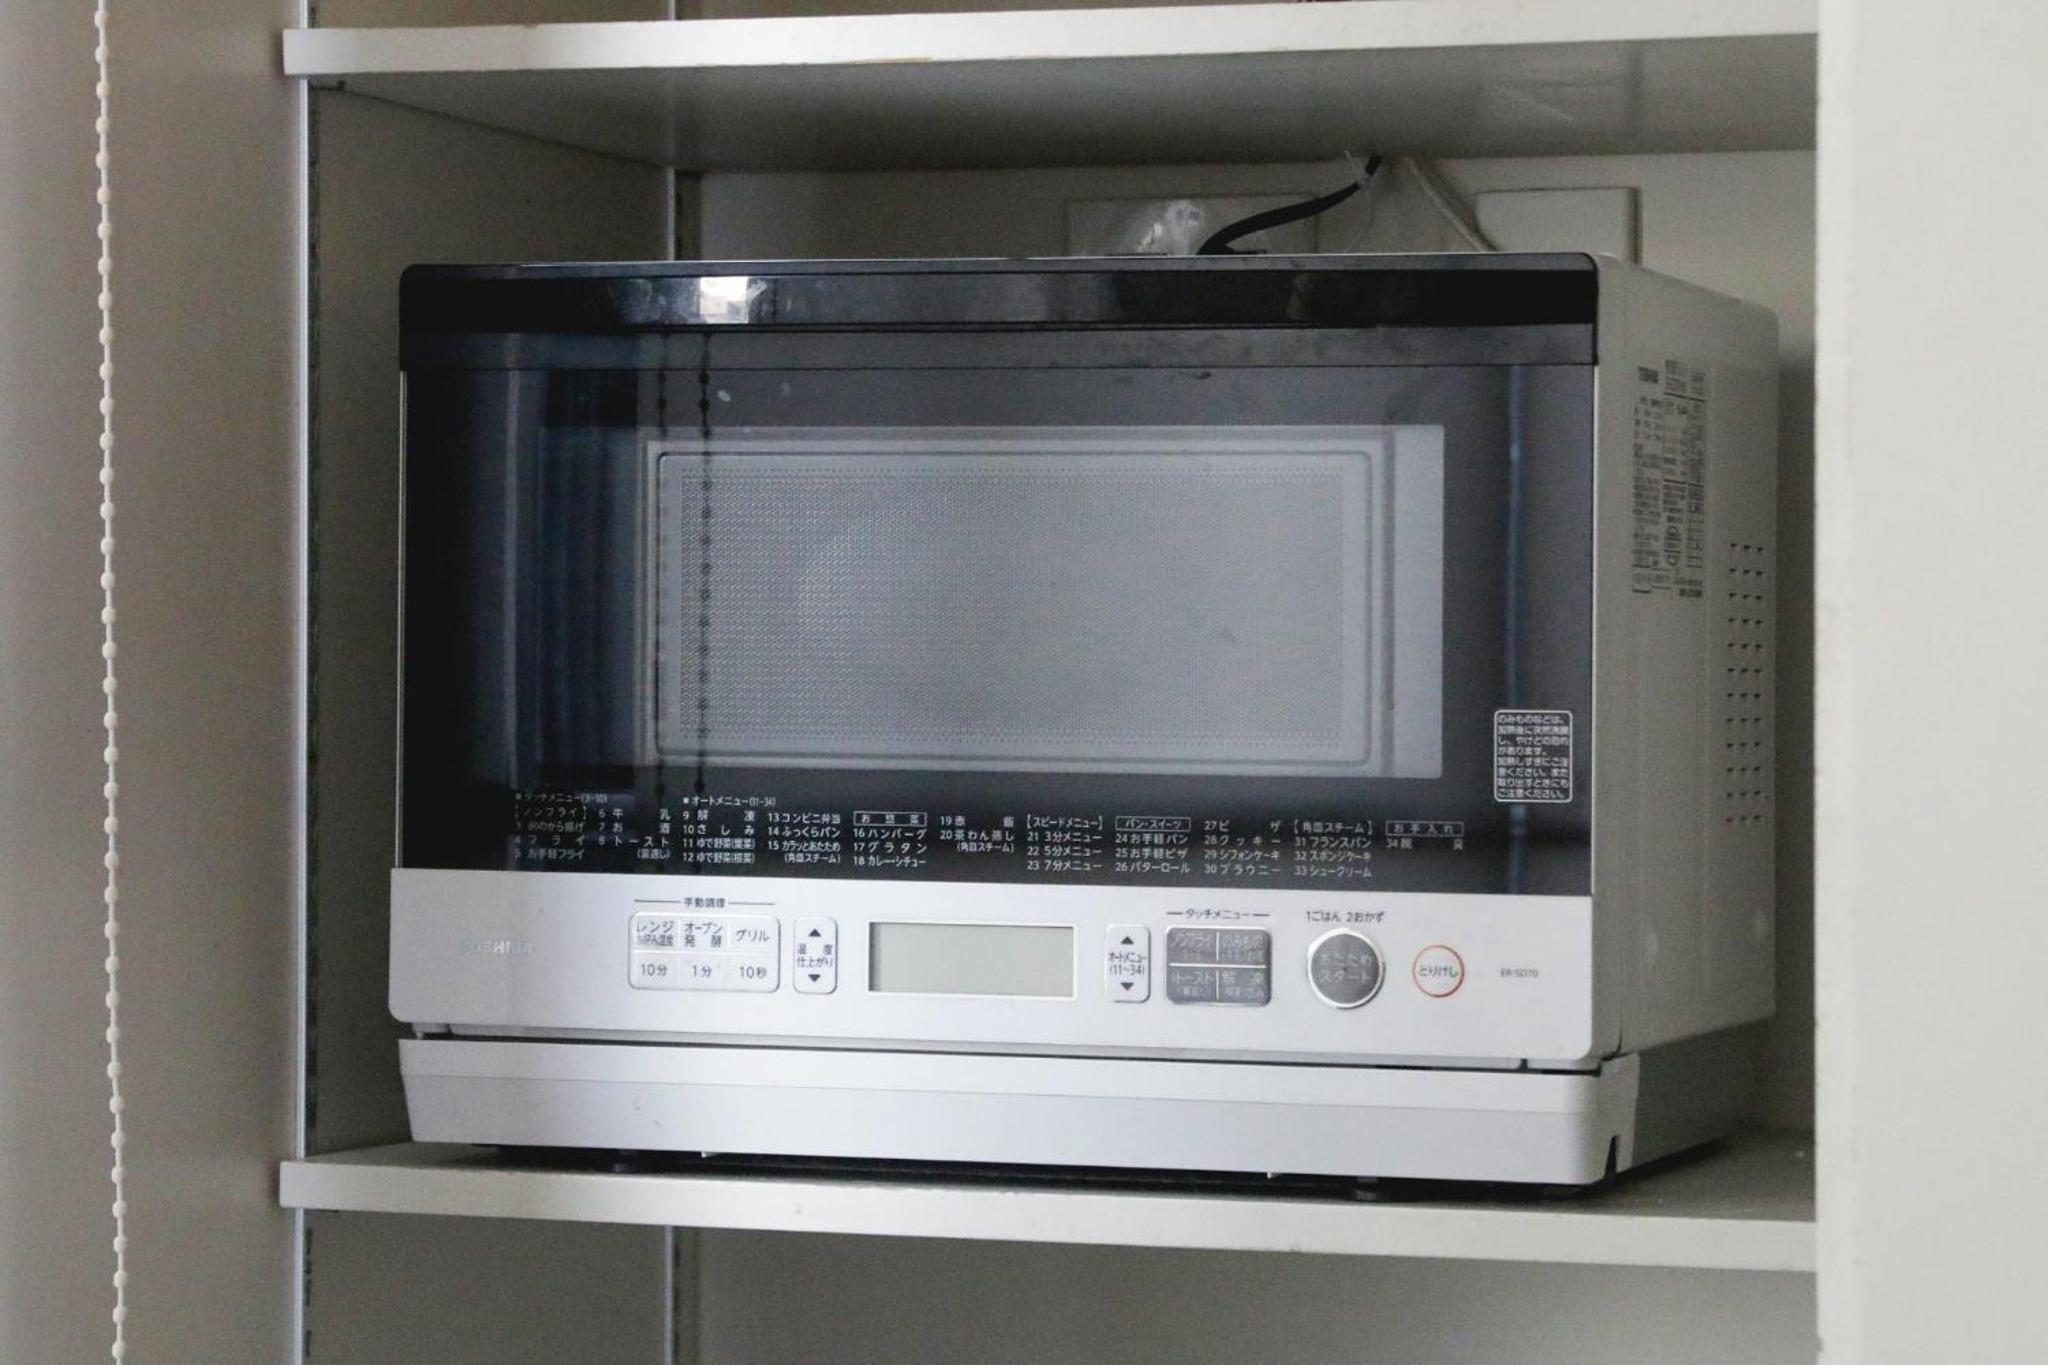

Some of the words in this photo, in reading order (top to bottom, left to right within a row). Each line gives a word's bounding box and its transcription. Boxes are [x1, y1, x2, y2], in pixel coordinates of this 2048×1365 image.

[782, 813, 841, 825] コンビニ弁当
[782, 827, 841, 838] ふっくらパン
[868, 828, 927, 840] ハンバーグ
[1045, 831, 1102, 843] 3分メニュー
[1309, 837, 1372, 849] フランスパン
[1045, 845, 1102, 857] 5分メニュー
[1045, 860, 1102, 872] 7分メニュー
[1130, 862, 1191, 874] バターロール
[684, 897, 726, 909] 手動調理
[636, 920, 675, 933] レンジ
[735, 928, 770, 942] グリル
[640, 963, 668, 977] 10分
[739, 965, 767, 979] 10秒
[1419, 966, 1459, 979] とりけし
